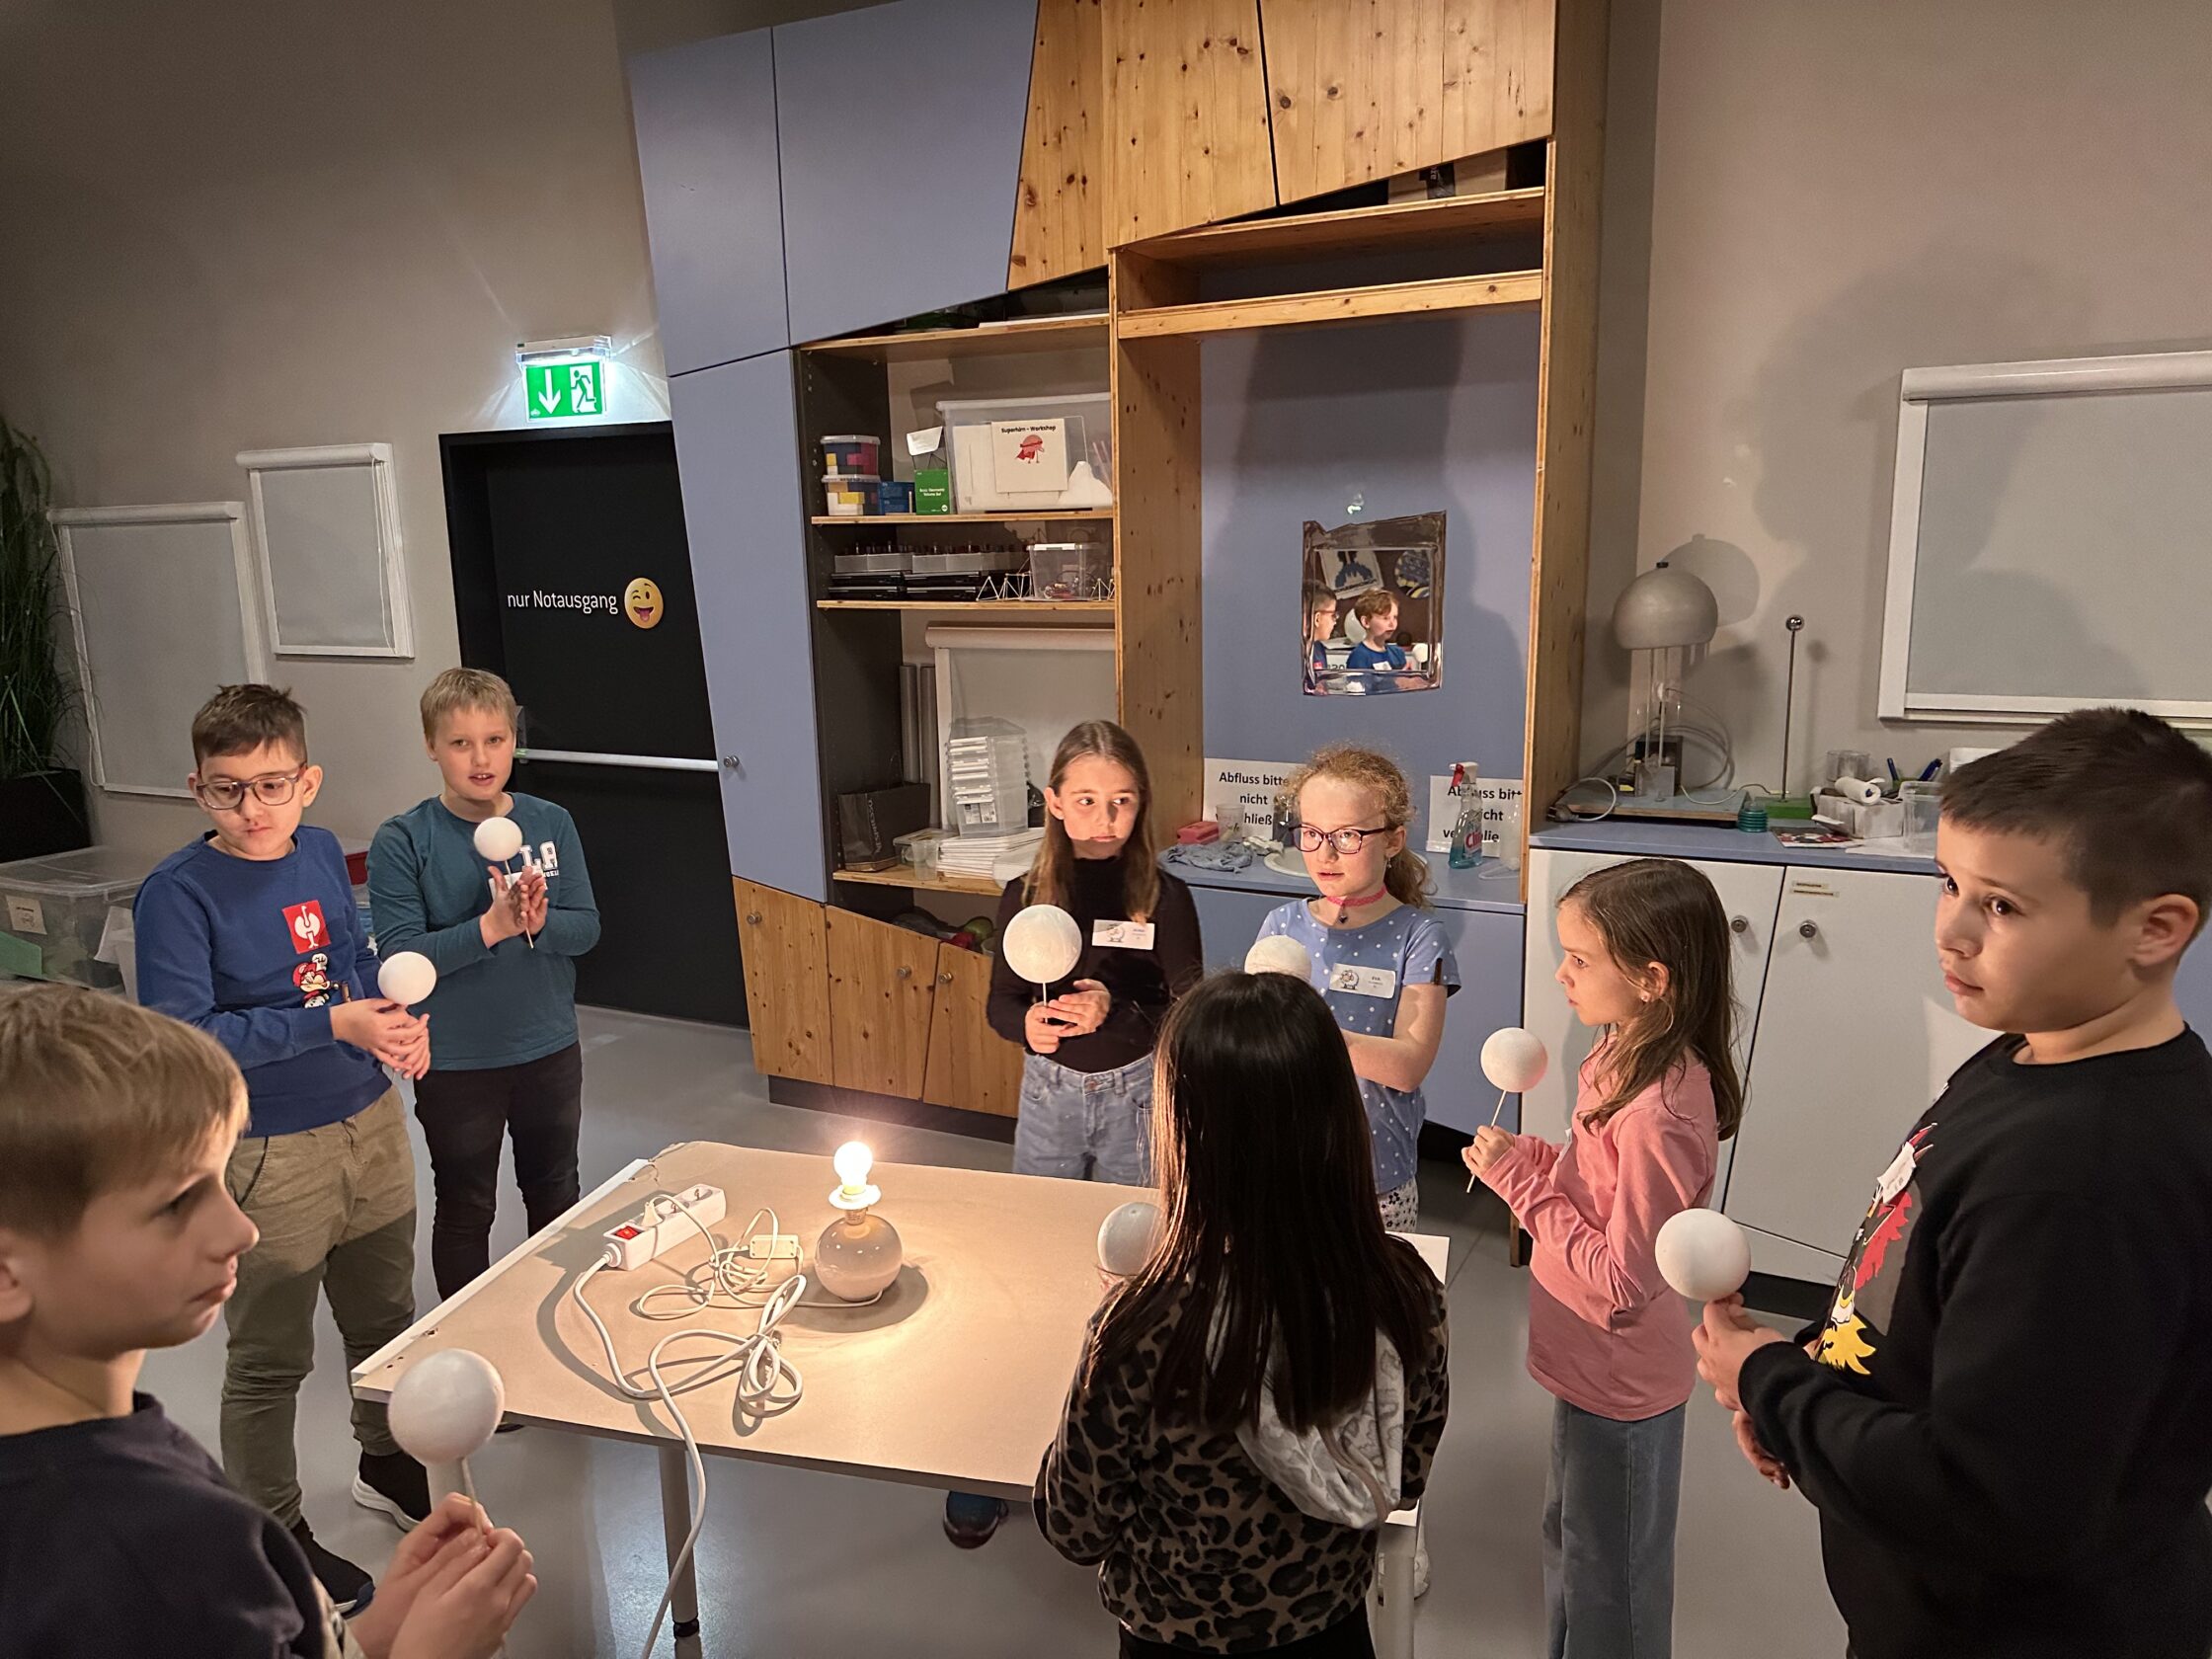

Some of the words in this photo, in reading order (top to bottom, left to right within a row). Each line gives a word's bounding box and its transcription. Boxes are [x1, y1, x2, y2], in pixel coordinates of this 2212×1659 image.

[508, 593, 530, 608] nur
[533, 590, 618, 614] Notausgang
[1219, 771, 1260, 784] Abfluss
[1239, 793, 1268, 805] nicht
